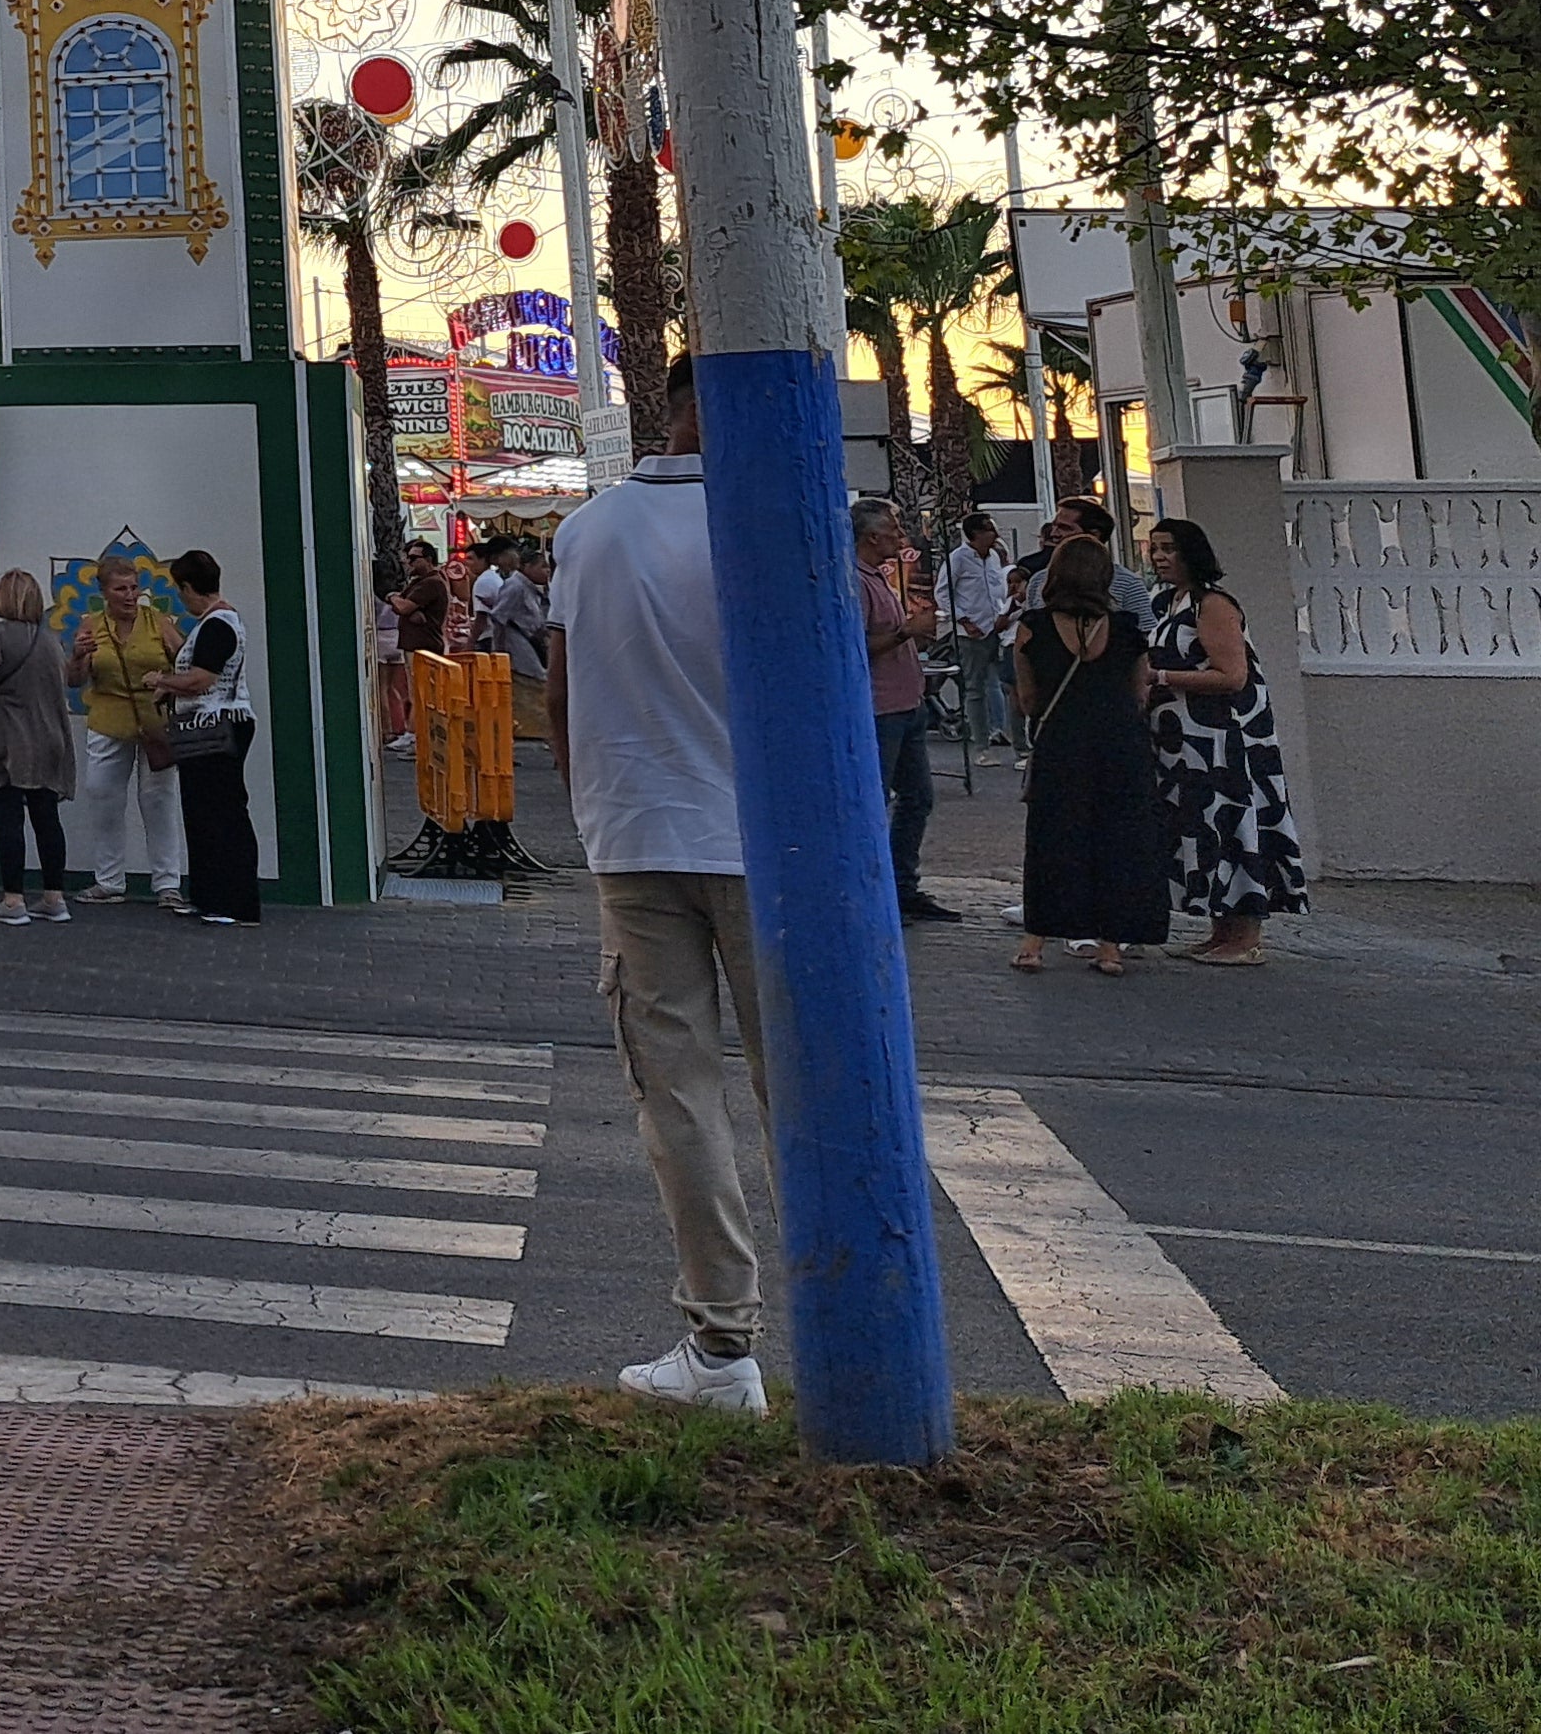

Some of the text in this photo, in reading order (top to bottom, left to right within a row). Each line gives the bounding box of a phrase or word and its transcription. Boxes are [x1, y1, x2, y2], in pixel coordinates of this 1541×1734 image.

[387, 380, 445, 395] ETTES
[388, 399, 446, 414] WICH
[492, 393, 582, 423] HAMBURGUESERIA
[393, 418, 448, 433] NINIS
[504, 425, 579, 453] BOCATERIA
